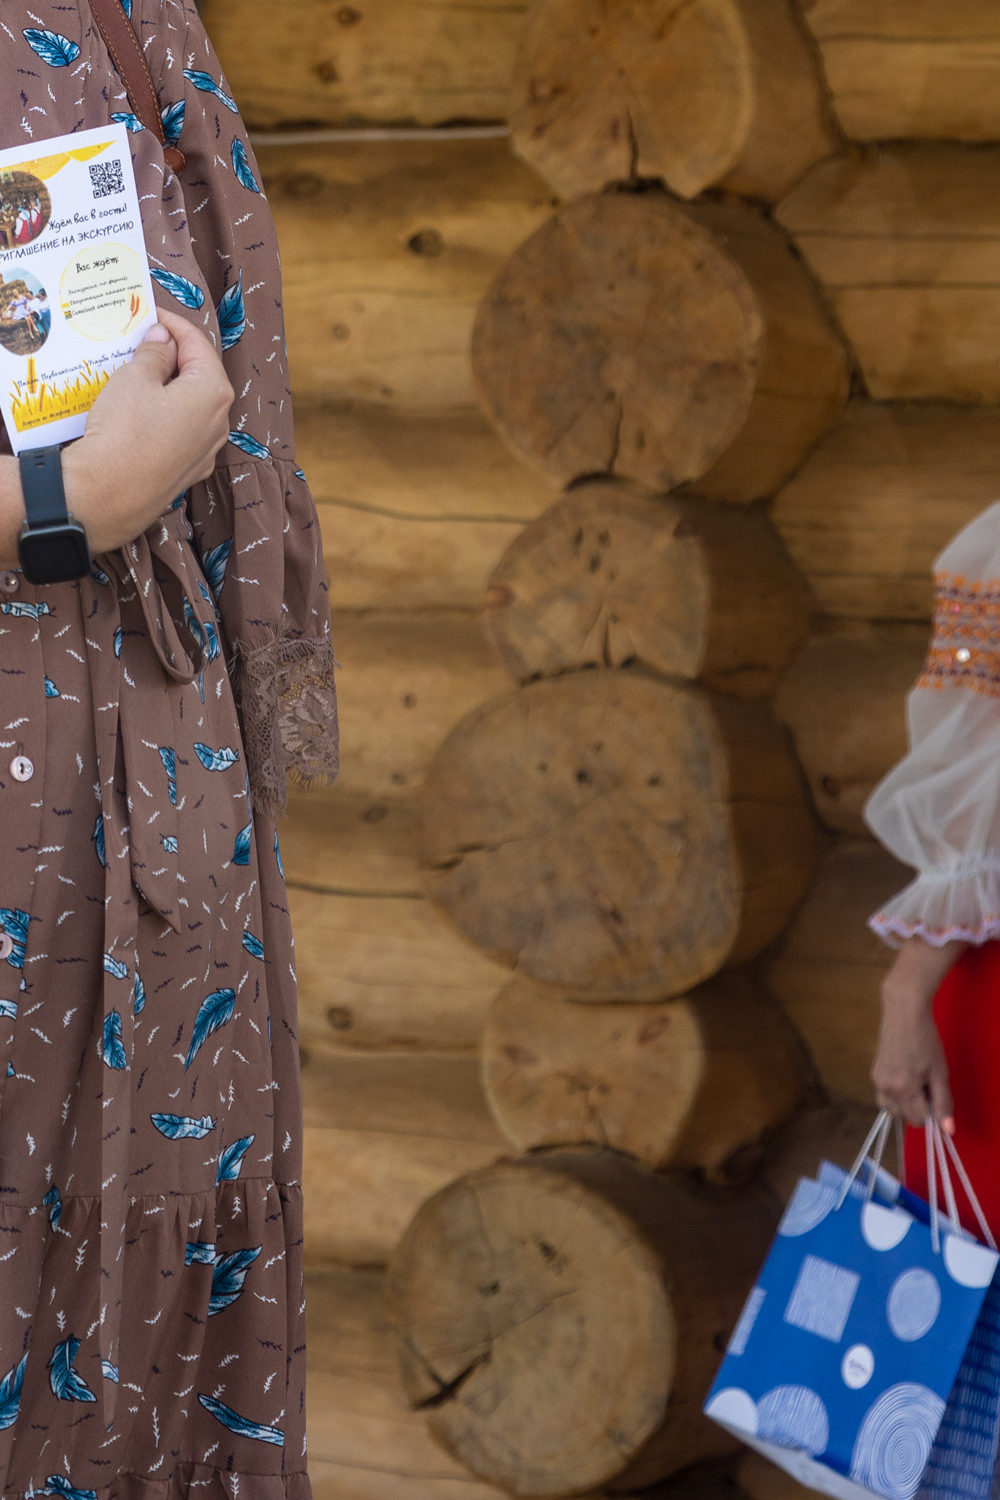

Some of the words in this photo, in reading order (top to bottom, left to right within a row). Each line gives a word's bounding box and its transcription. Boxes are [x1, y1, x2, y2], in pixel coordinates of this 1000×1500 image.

[73, 213, 89, 224] вас
[90, 209, 97, 219] в
[98, 203, 128, 218] гости!
[61, 234, 76, 247] НА
[78, 220, 135, 242] ЭКСКУРСИЮ
[75, 263, 91, 274] Вас
